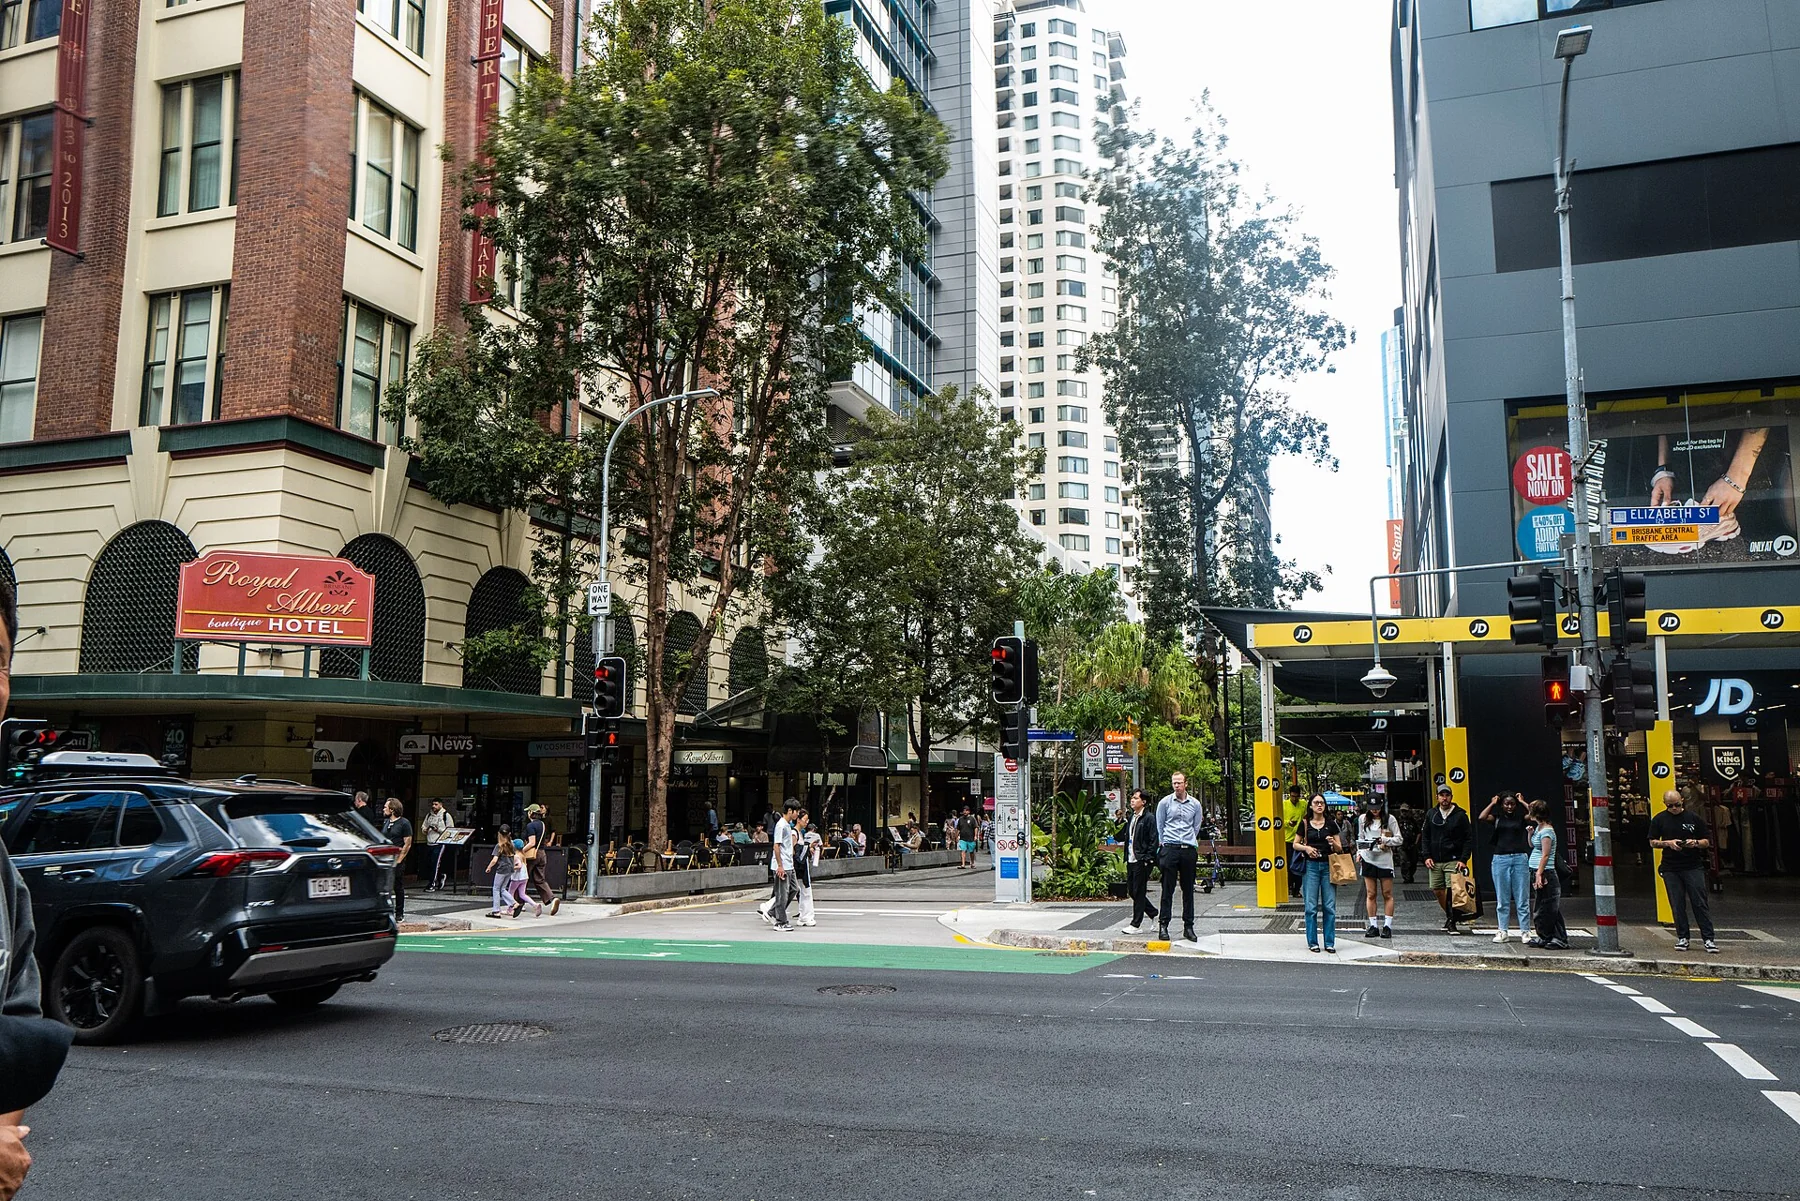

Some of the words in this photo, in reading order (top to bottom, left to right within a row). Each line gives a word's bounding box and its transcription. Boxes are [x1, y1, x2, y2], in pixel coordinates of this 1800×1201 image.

[481, 0, 500, 100] BERT
[58, 171, 73, 238] 2013
[1526, 453, 1564, 481] SALE
[1527, 480, 1549, 497] NOW
[1551, 479, 1565, 496] ON
[1630, 508, 1692, 519] ELIZABETH
[1699, 507, 1711, 519] ST
[1553, 514, 1563, 525] OFF
[1631, 527, 1663, 535] BRISBANE
[1632, 534, 1659, 542] TRAFFIC
[1765, 540, 1773, 552] AT
[1776, 540, 1795, 551] JD
[202, 559, 300, 598] Royal
[591, 585, 608, 593] ONE
[266, 588, 358, 616] Albert
[591, 595, 608, 603] WAY
[207, 616, 264, 631] boutique
[268, 618, 344, 634] HOTEL
[1660, 616, 1678, 627] JD
[1763, 614, 1781, 625] JD
[1295, 629, 1310, 639] JD
[1382, 626, 1397, 636] JD
[1471, 623, 1488, 634] JD
[1694, 678, 1754, 715] JD
[1371, 718, 1388, 730] JD
[431, 735, 474, 751] News
[544, 742, 586, 751] COSMETIC
[86, 755, 105, 763] Silver
[1451, 770, 1464, 780] JD
[1653, 766, 1668, 775] JD
[1258, 779, 1269, 787] JD
[1435, 775, 1445, 783] JD
[1259, 820, 1270, 828] JD
[1260, 861, 1271, 869] JD
